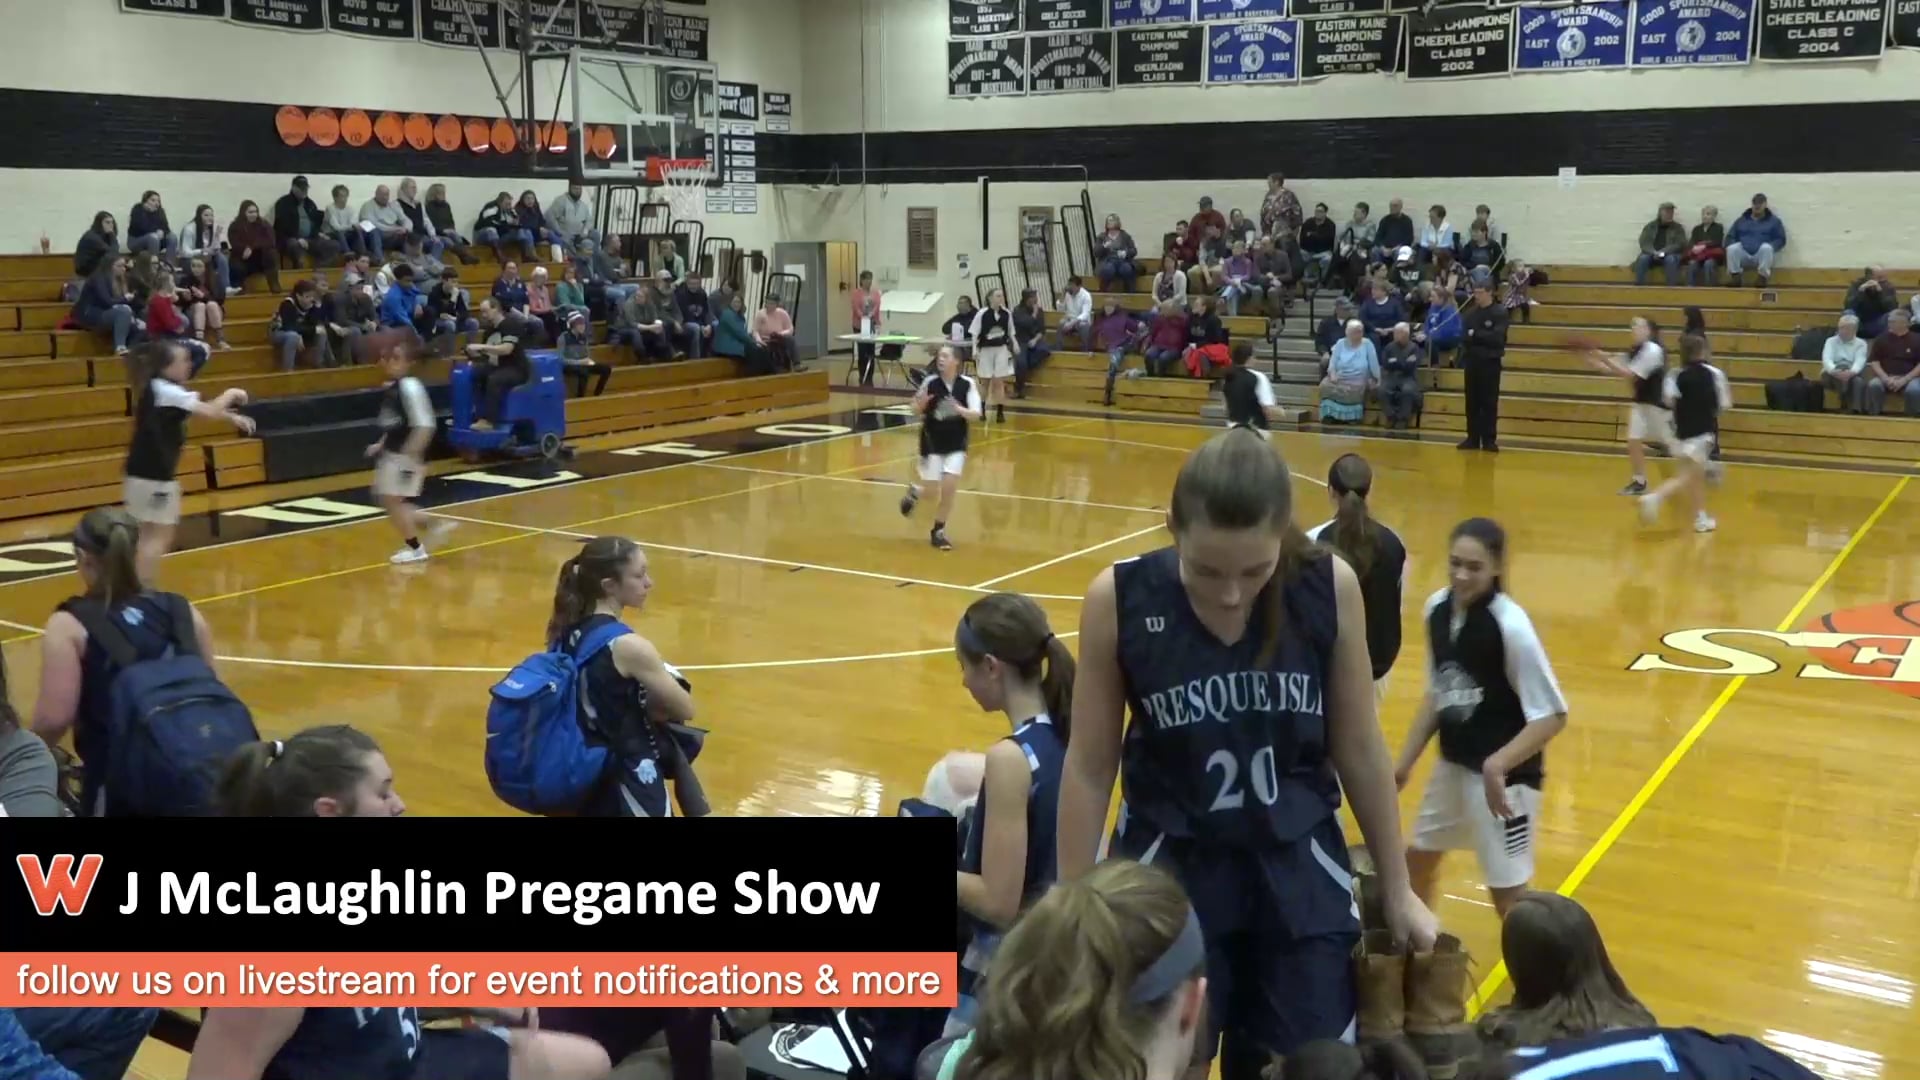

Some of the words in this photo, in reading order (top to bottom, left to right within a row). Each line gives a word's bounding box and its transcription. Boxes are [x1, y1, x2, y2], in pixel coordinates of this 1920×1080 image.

[1769, 0, 1806, 9] STATE
[1897, 3, 1920, 14] EAST
[255, 9, 289, 22] CLASS
[1640, 6, 1665, 26] GOOD
[1669, 0, 1747, 20] SPORTSMANSHIP
[1677, 7, 1711, 18] AWARD
[1766, 8, 1881, 26] CHEERLEADING
[1315, 19, 1357, 32] EASTERN
[1360, 17, 1388, 29] MAINE
[1444, 12, 1510, 32] CHAMPIONS
[1522, 15, 1546, 34] GOOD
[1550, 5, 1624, 28] SPORTSMANSHIP
[1557, 15, 1589, 28] AWARD
[1131, 31, 1165, 41] EASTERN
[1167, 30, 1190, 40] MAINE
[1318, 30, 1383, 44] CHAMPIONS
[1413, 29, 1505, 47] CHEERLEADING
[1641, 33, 1667, 45] EAST
[1715, 31, 1741, 41] 2004
[1787, 27, 1838, 39] CLASS
[1843, 27, 1855, 37] C
[1140, 41, 1179, 51] CHAMPIONS
[1525, 39, 1550, 49] EAST
[1594, 35, 1620, 46] 2002
[1335, 43, 1365, 53] 2001
[1430, 47, 1473, 60] CLASS
[1798, 42, 1840, 54] 2004
[1316, 53, 1381, 64] CHEERLEADING
[1134, 62, 1184, 72] CHEERLEADING
[1323, 63, 1362, 73] CLASS
[1441, 60, 1475, 72] 2002
[1143, 72, 1166, 81] CLASS
[1205, 745, 1279, 813] 20
